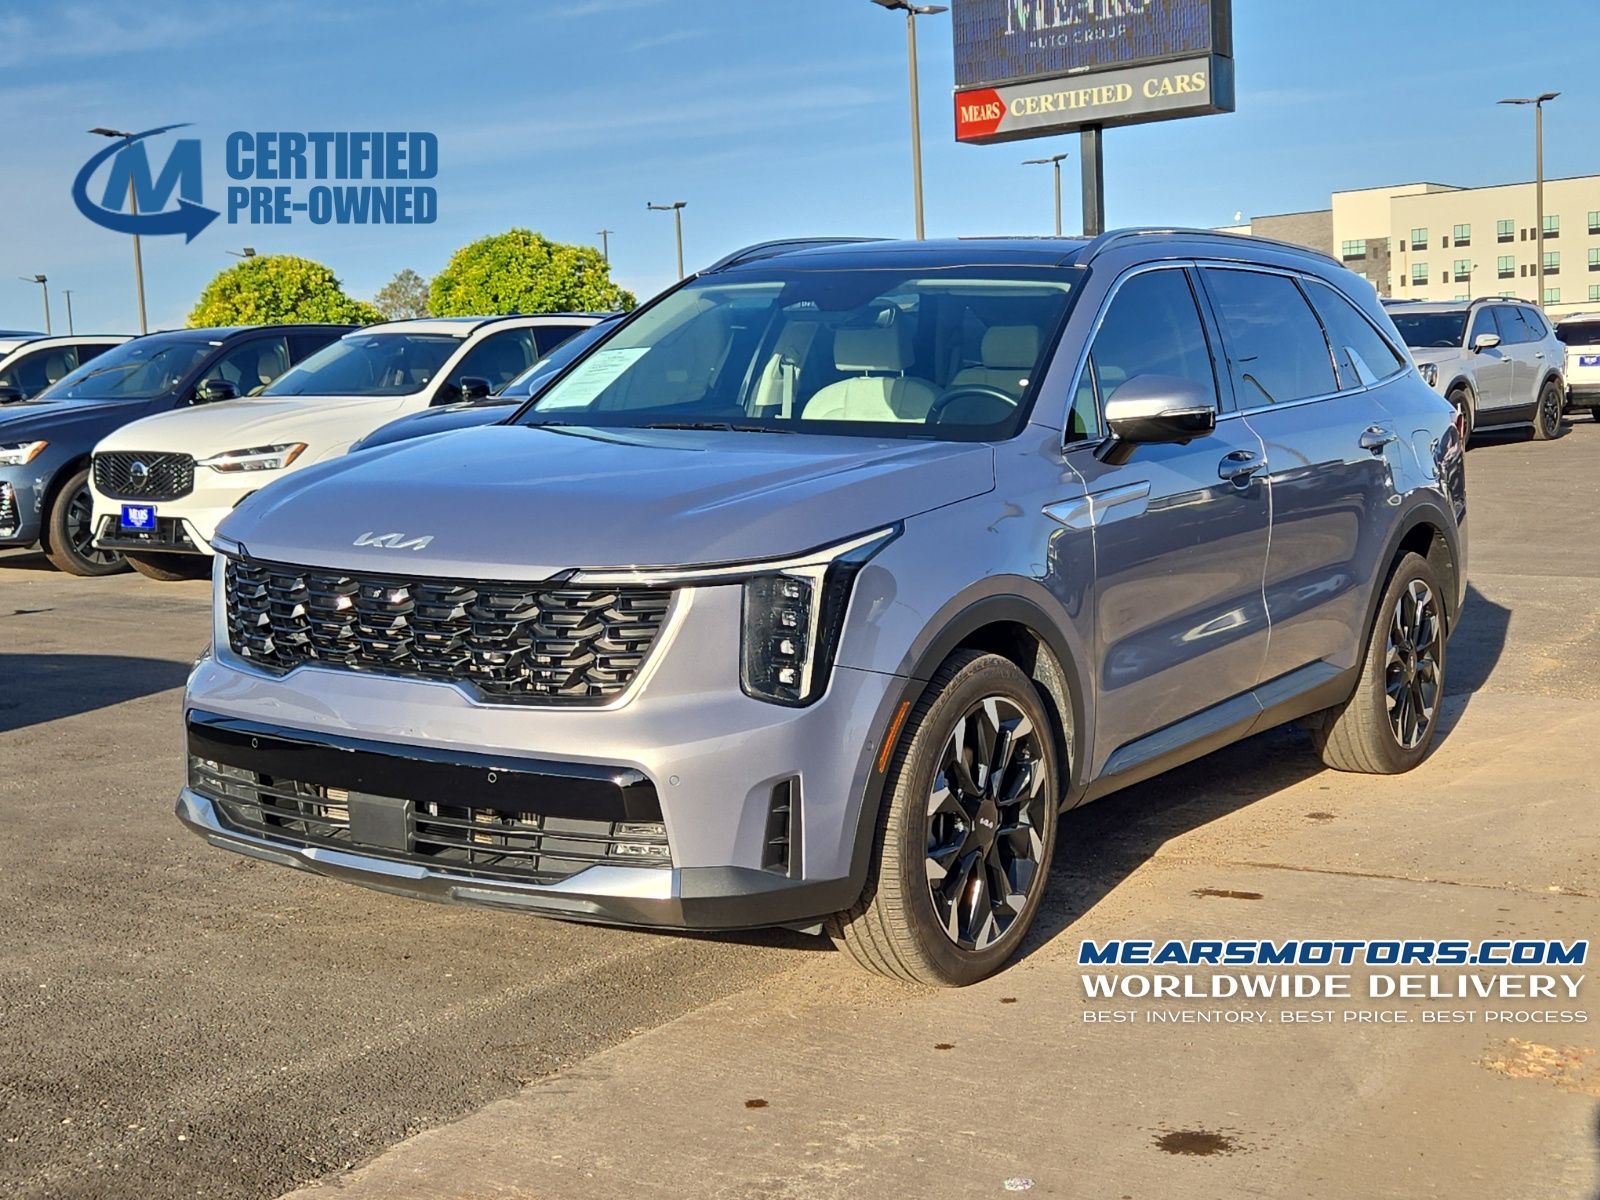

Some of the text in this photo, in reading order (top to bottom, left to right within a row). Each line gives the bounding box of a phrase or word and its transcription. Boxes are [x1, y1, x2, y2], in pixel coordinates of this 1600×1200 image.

[1010, 71, 1206, 117] CERTIFIED CARS
[961, 101, 1001, 124] MEARS
[352, 531, 435, 551] KIA
